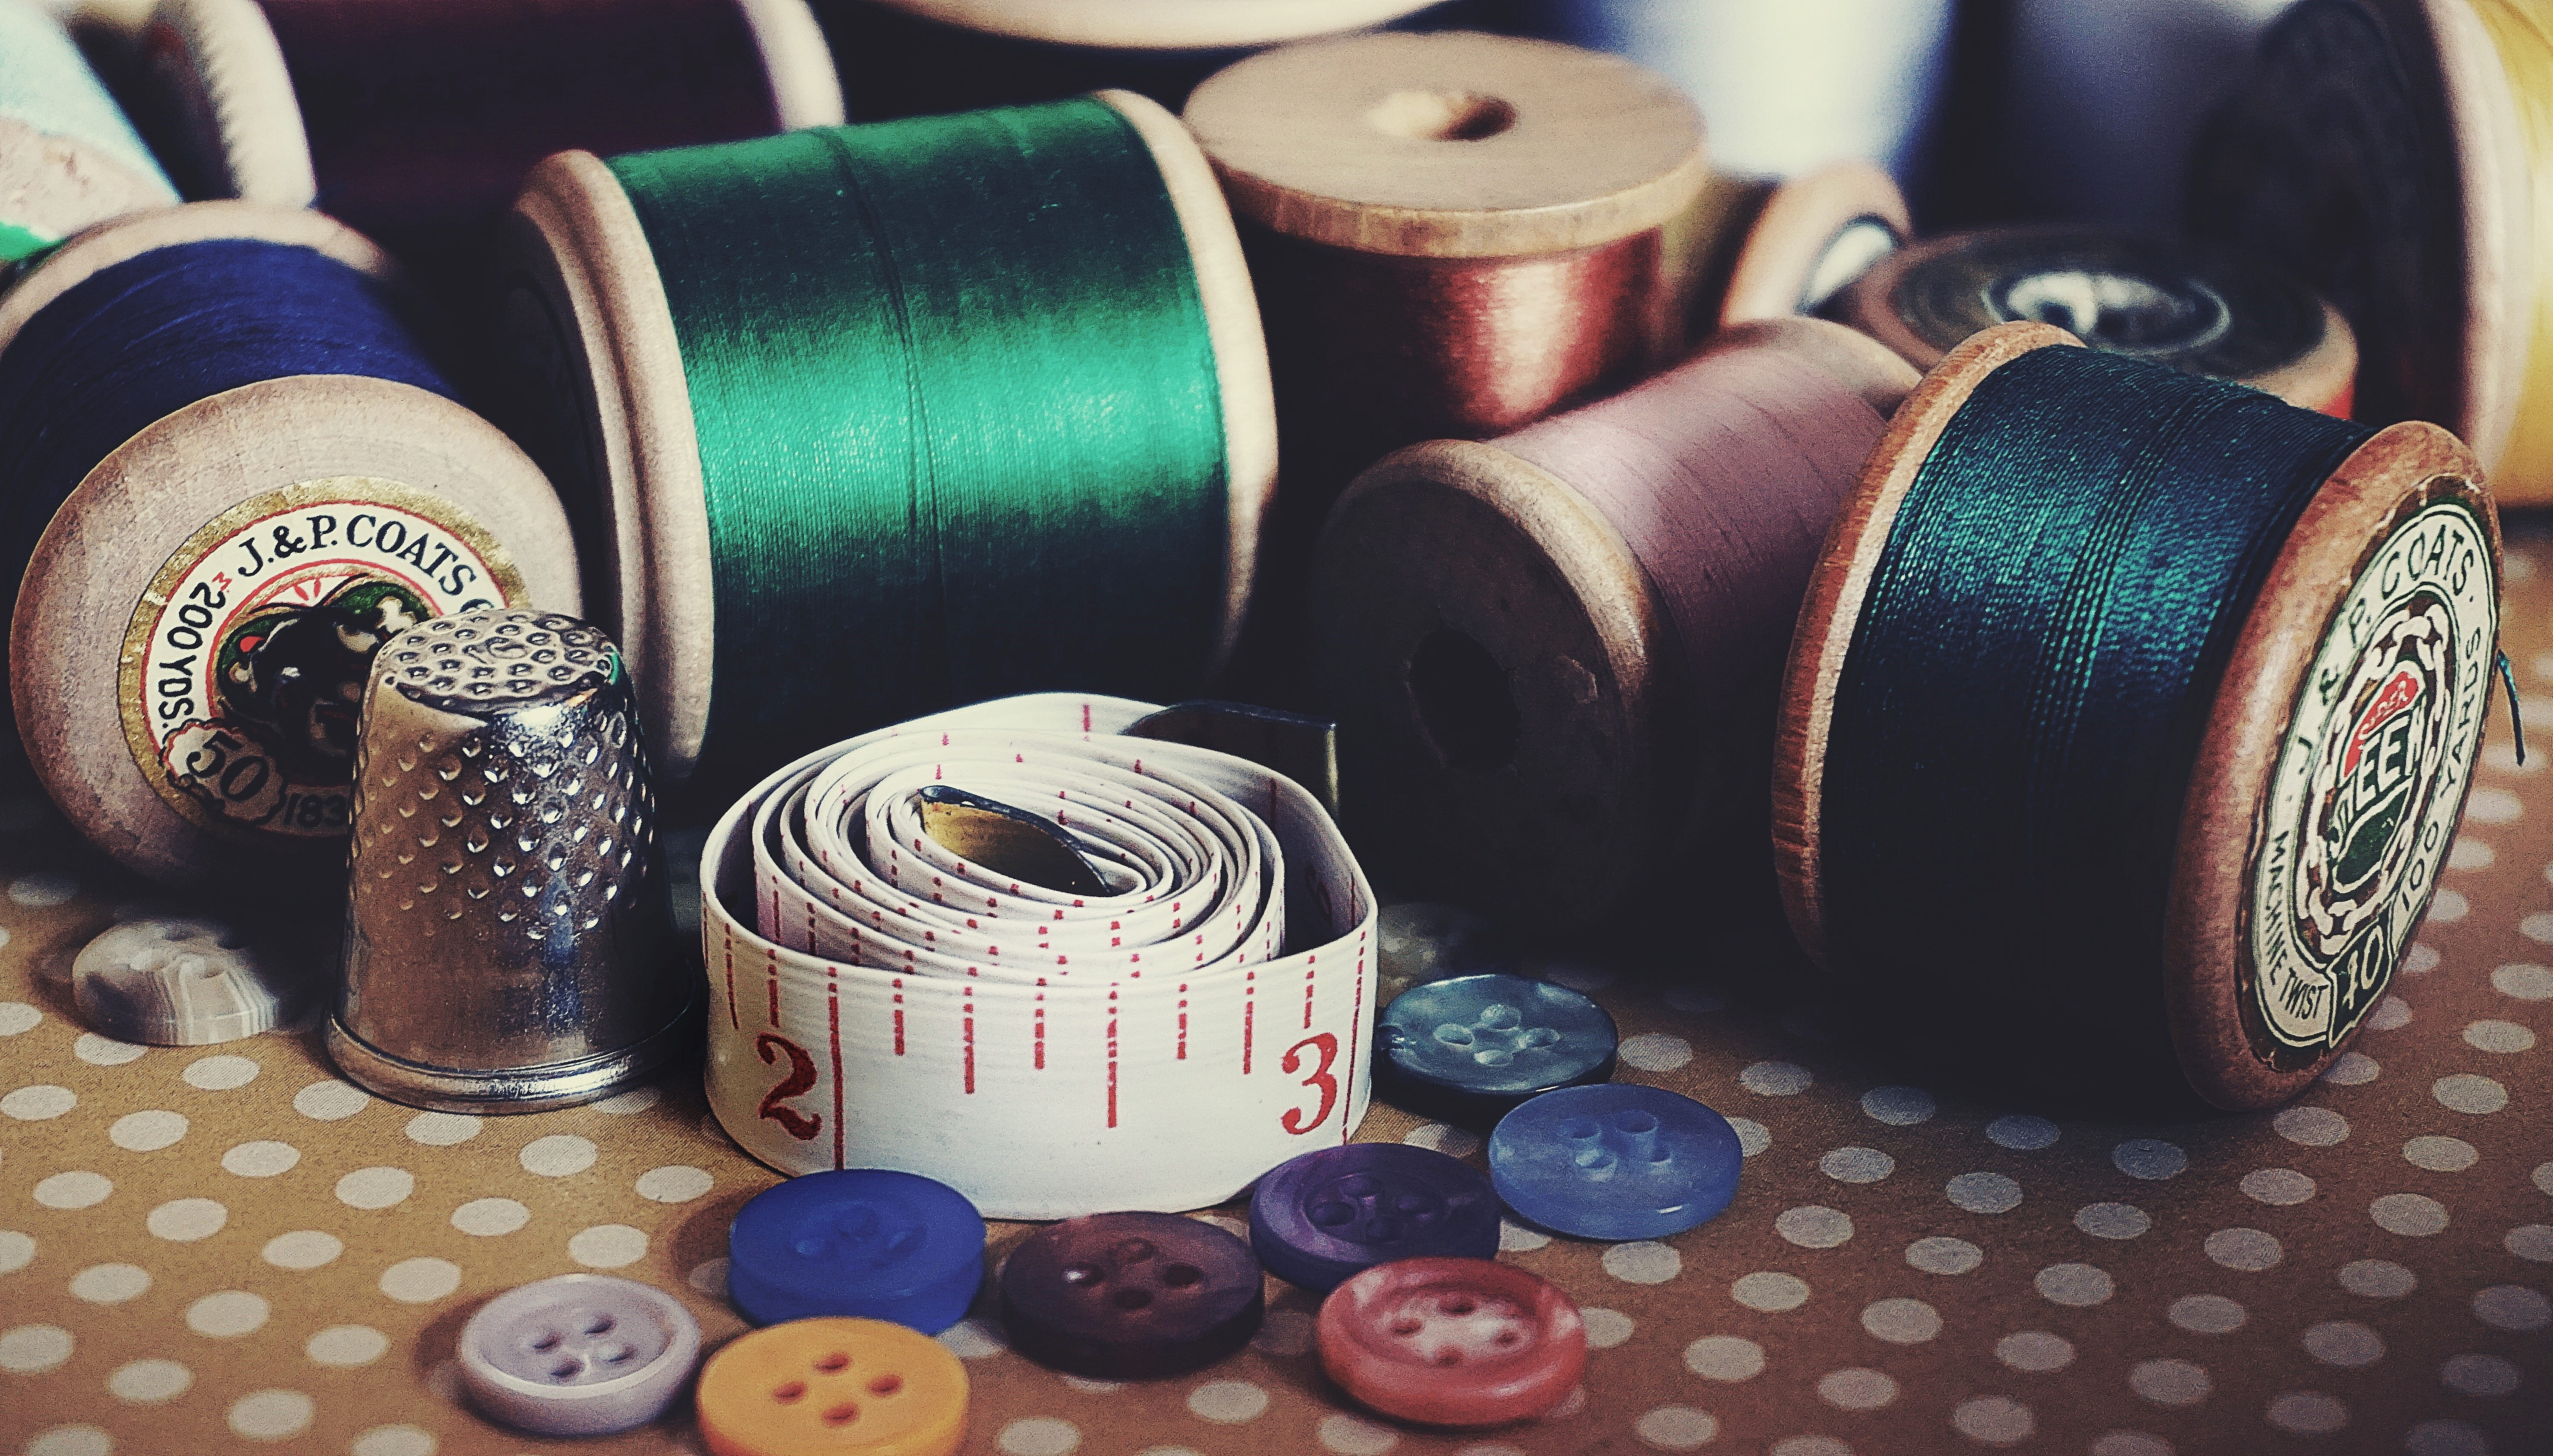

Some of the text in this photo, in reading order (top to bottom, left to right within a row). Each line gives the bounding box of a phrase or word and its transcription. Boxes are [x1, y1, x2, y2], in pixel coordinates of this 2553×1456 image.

[346, 514, 476, 596] COATS
[159, 582, 225, 728] 200 YDS.
[186, 731, 269, 801] 50
[2402, 627, 2481, 911] 100 YARDS
[283, 794, 346, 826] 183
[2280, 968, 2328, 1019] TWIST
[756, 1032, 1338, 1141] 2 3
